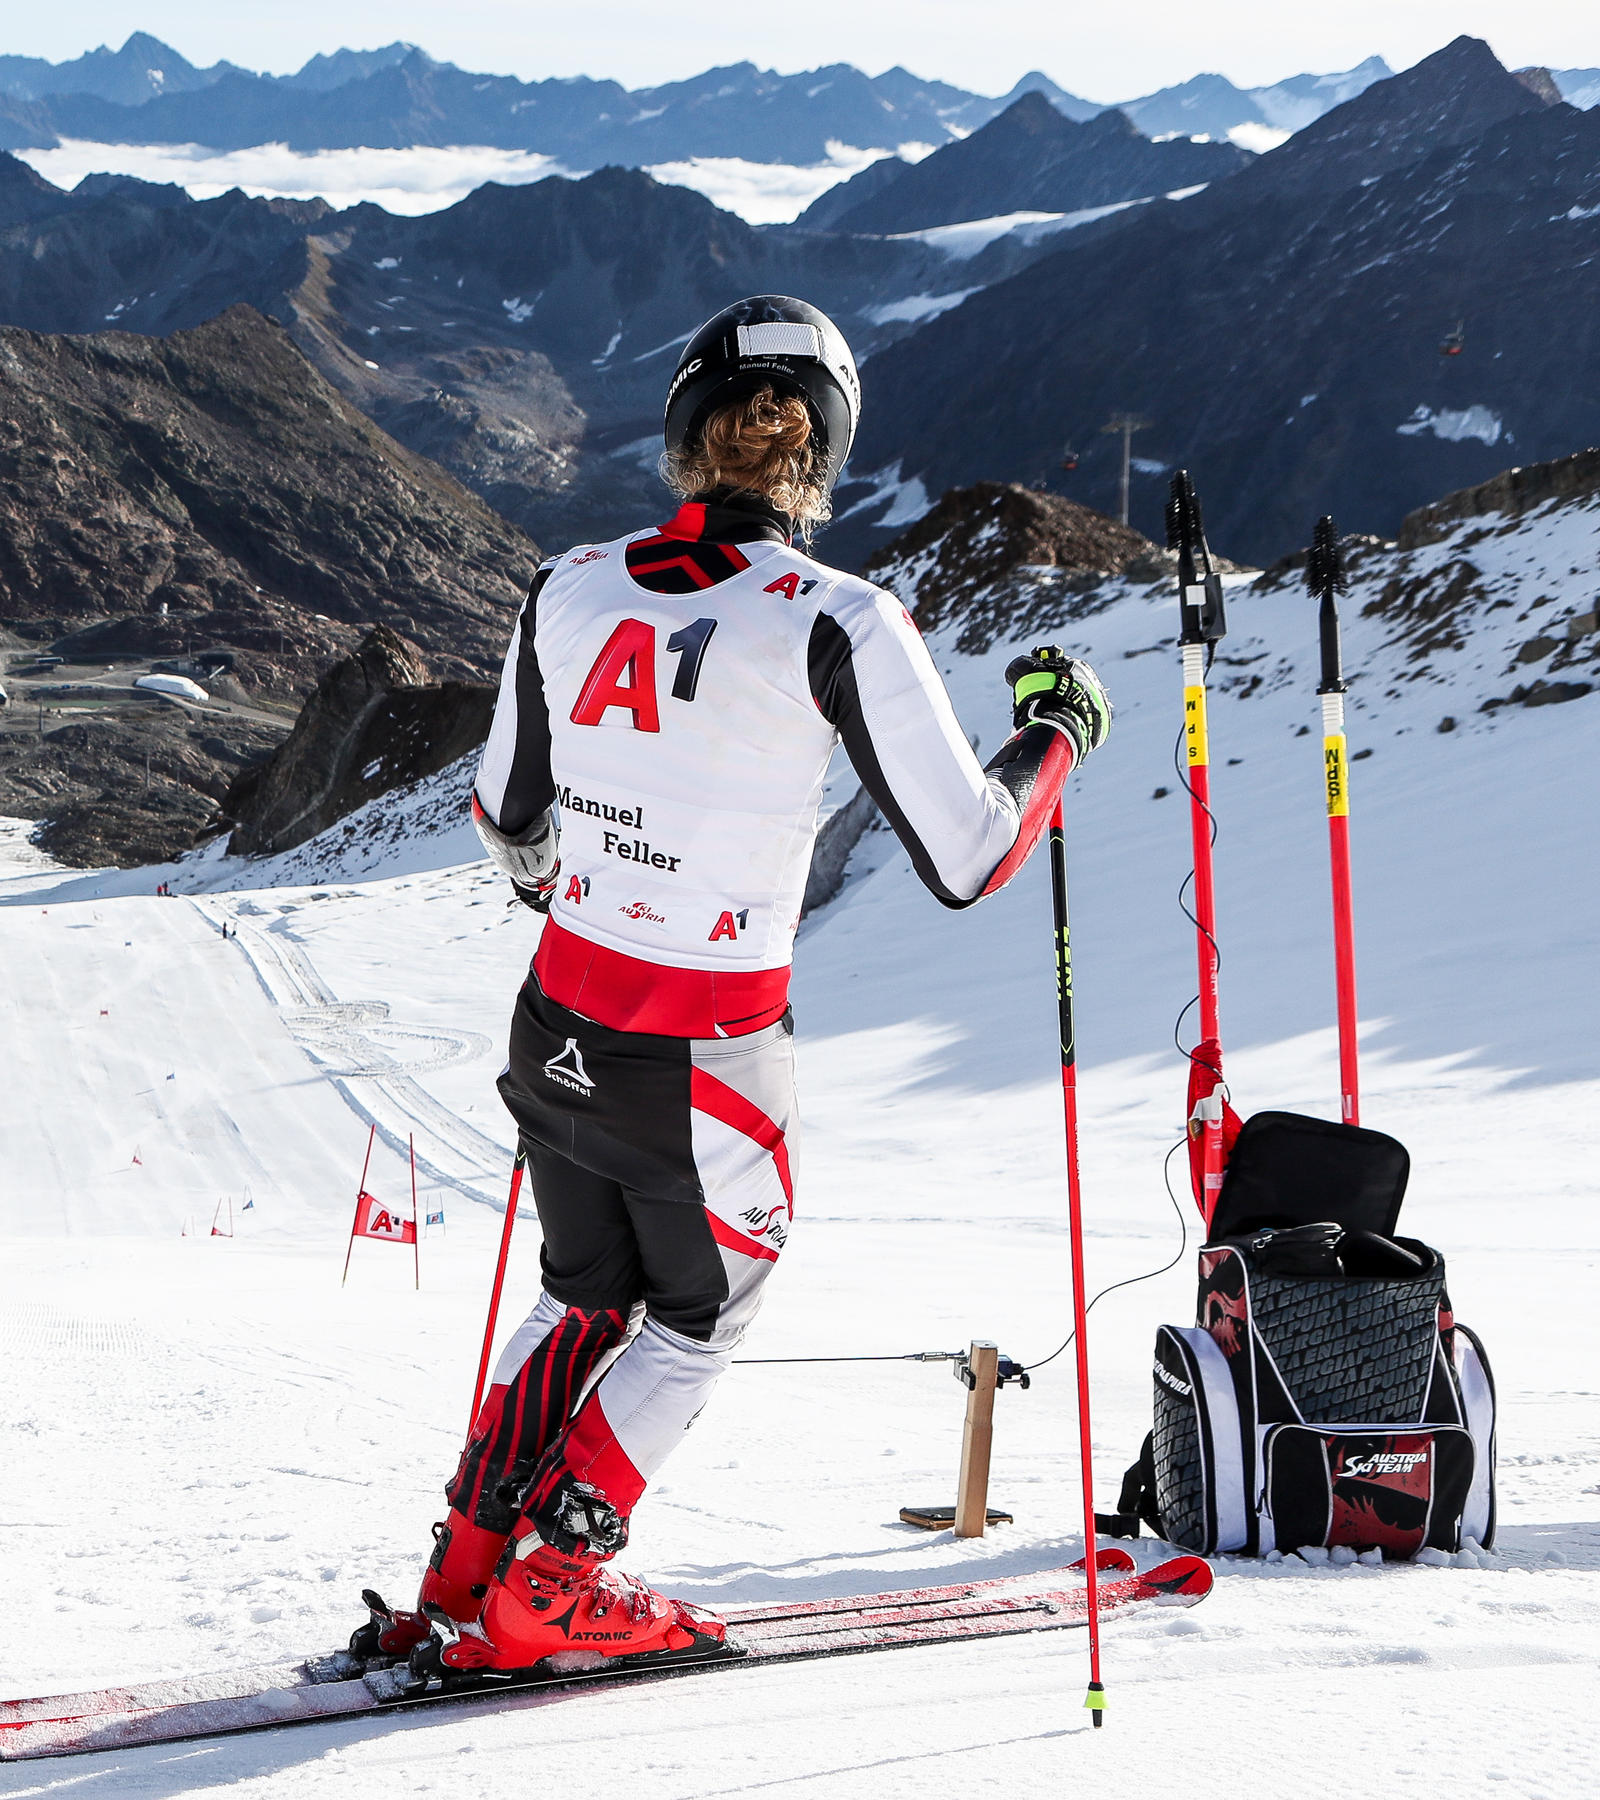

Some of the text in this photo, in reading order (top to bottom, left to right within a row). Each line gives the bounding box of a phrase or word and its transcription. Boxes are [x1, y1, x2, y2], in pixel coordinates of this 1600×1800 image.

[762, 572, 819, 600] A1
[570, 617, 718, 734] A1
[556, 784, 643, 829] Manuel
[603, 831, 681, 872] Feller
[564, 874, 591, 904] A1
[708, 908, 749, 941] A1
[544, 1068, 591, 1098] Schöffel
[1367, 1453, 1427, 1463] AUSTRIA
[1376, 1464, 1414, 1473] TEAM
[571, 1631, 633, 1641] ATOMIC
